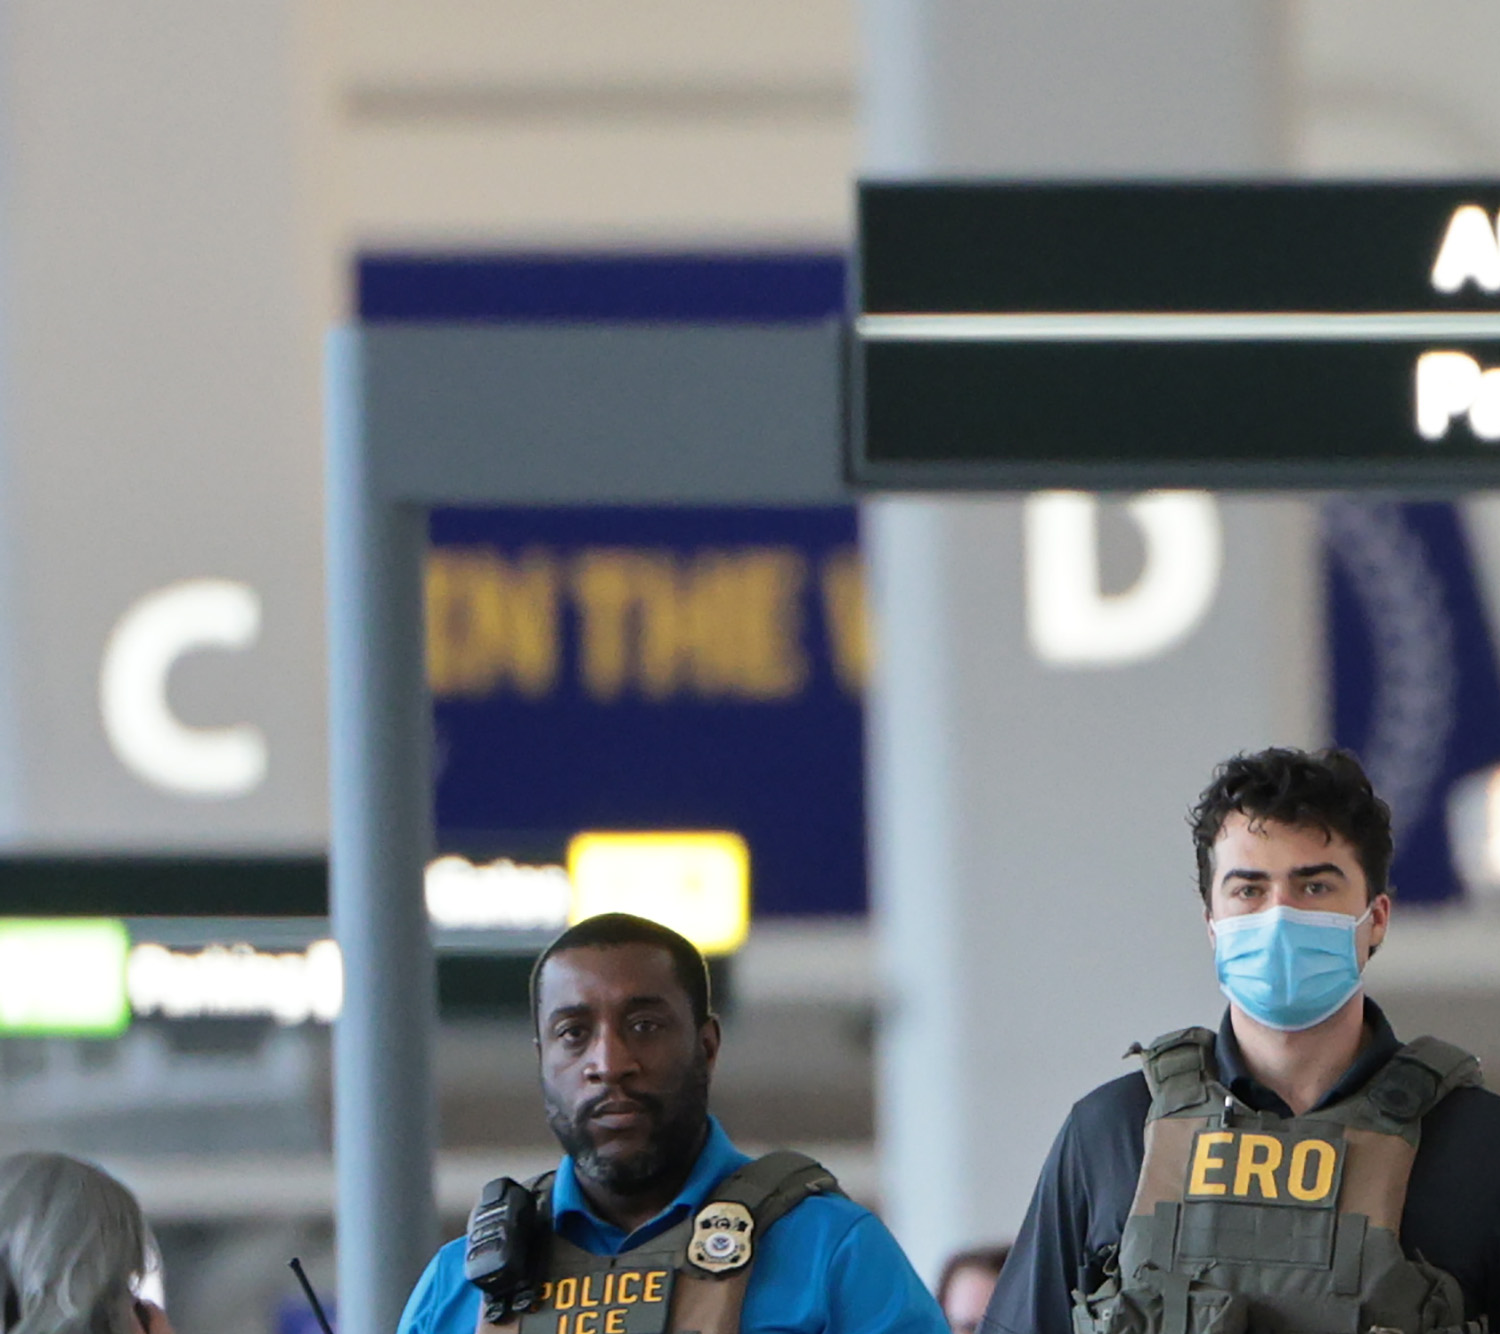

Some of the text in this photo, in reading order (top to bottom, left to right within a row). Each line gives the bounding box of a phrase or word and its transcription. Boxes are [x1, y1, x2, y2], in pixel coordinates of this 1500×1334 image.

[578, 546, 808, 698] THE
[1024, 489, 1224, 668] D
[101, 578, 268, 796] C
[1188, 1131, 1337, 1202] ERO
